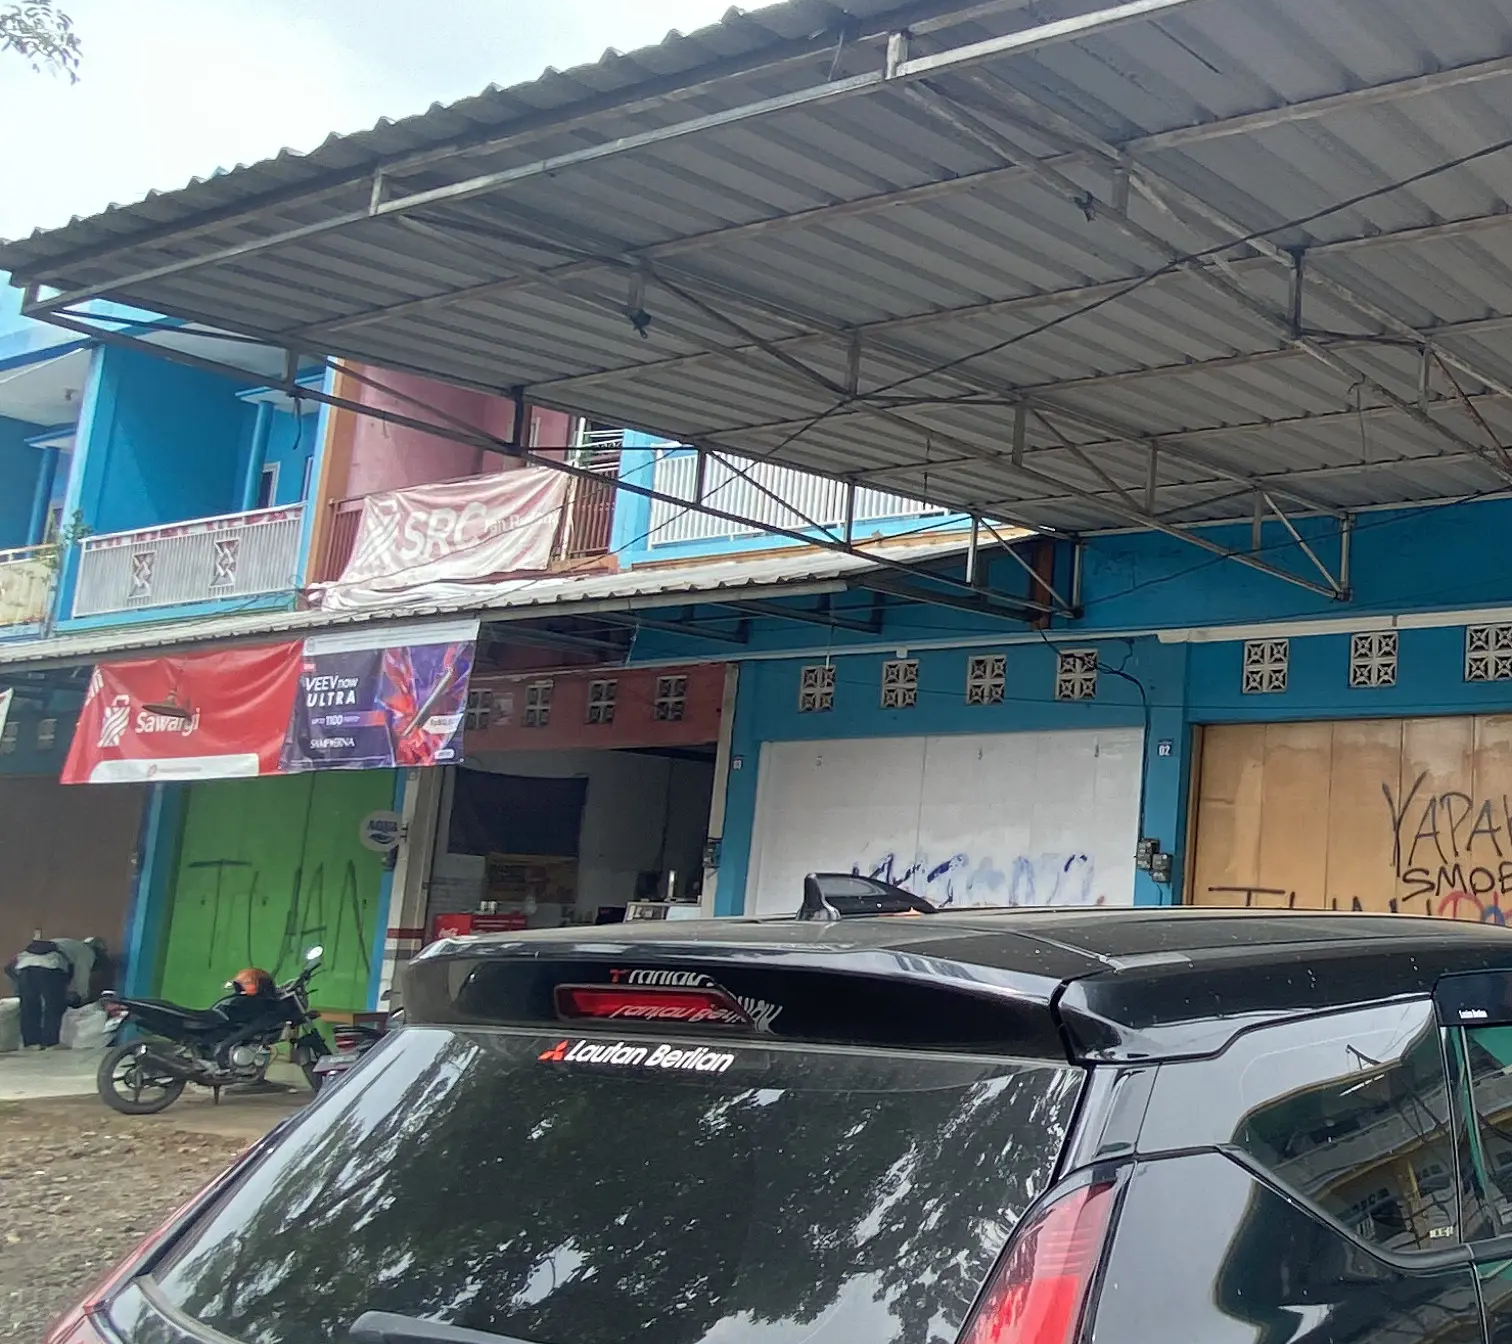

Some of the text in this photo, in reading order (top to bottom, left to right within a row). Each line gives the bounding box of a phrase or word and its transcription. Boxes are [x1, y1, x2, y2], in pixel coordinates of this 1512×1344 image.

[402, 502, 488, 558] SRC
[305, 675, 340, 691] VEEV
[306, 691, 357, 707] ULTRA
[564, 1040, 735, 1073] Lautan Berlian
